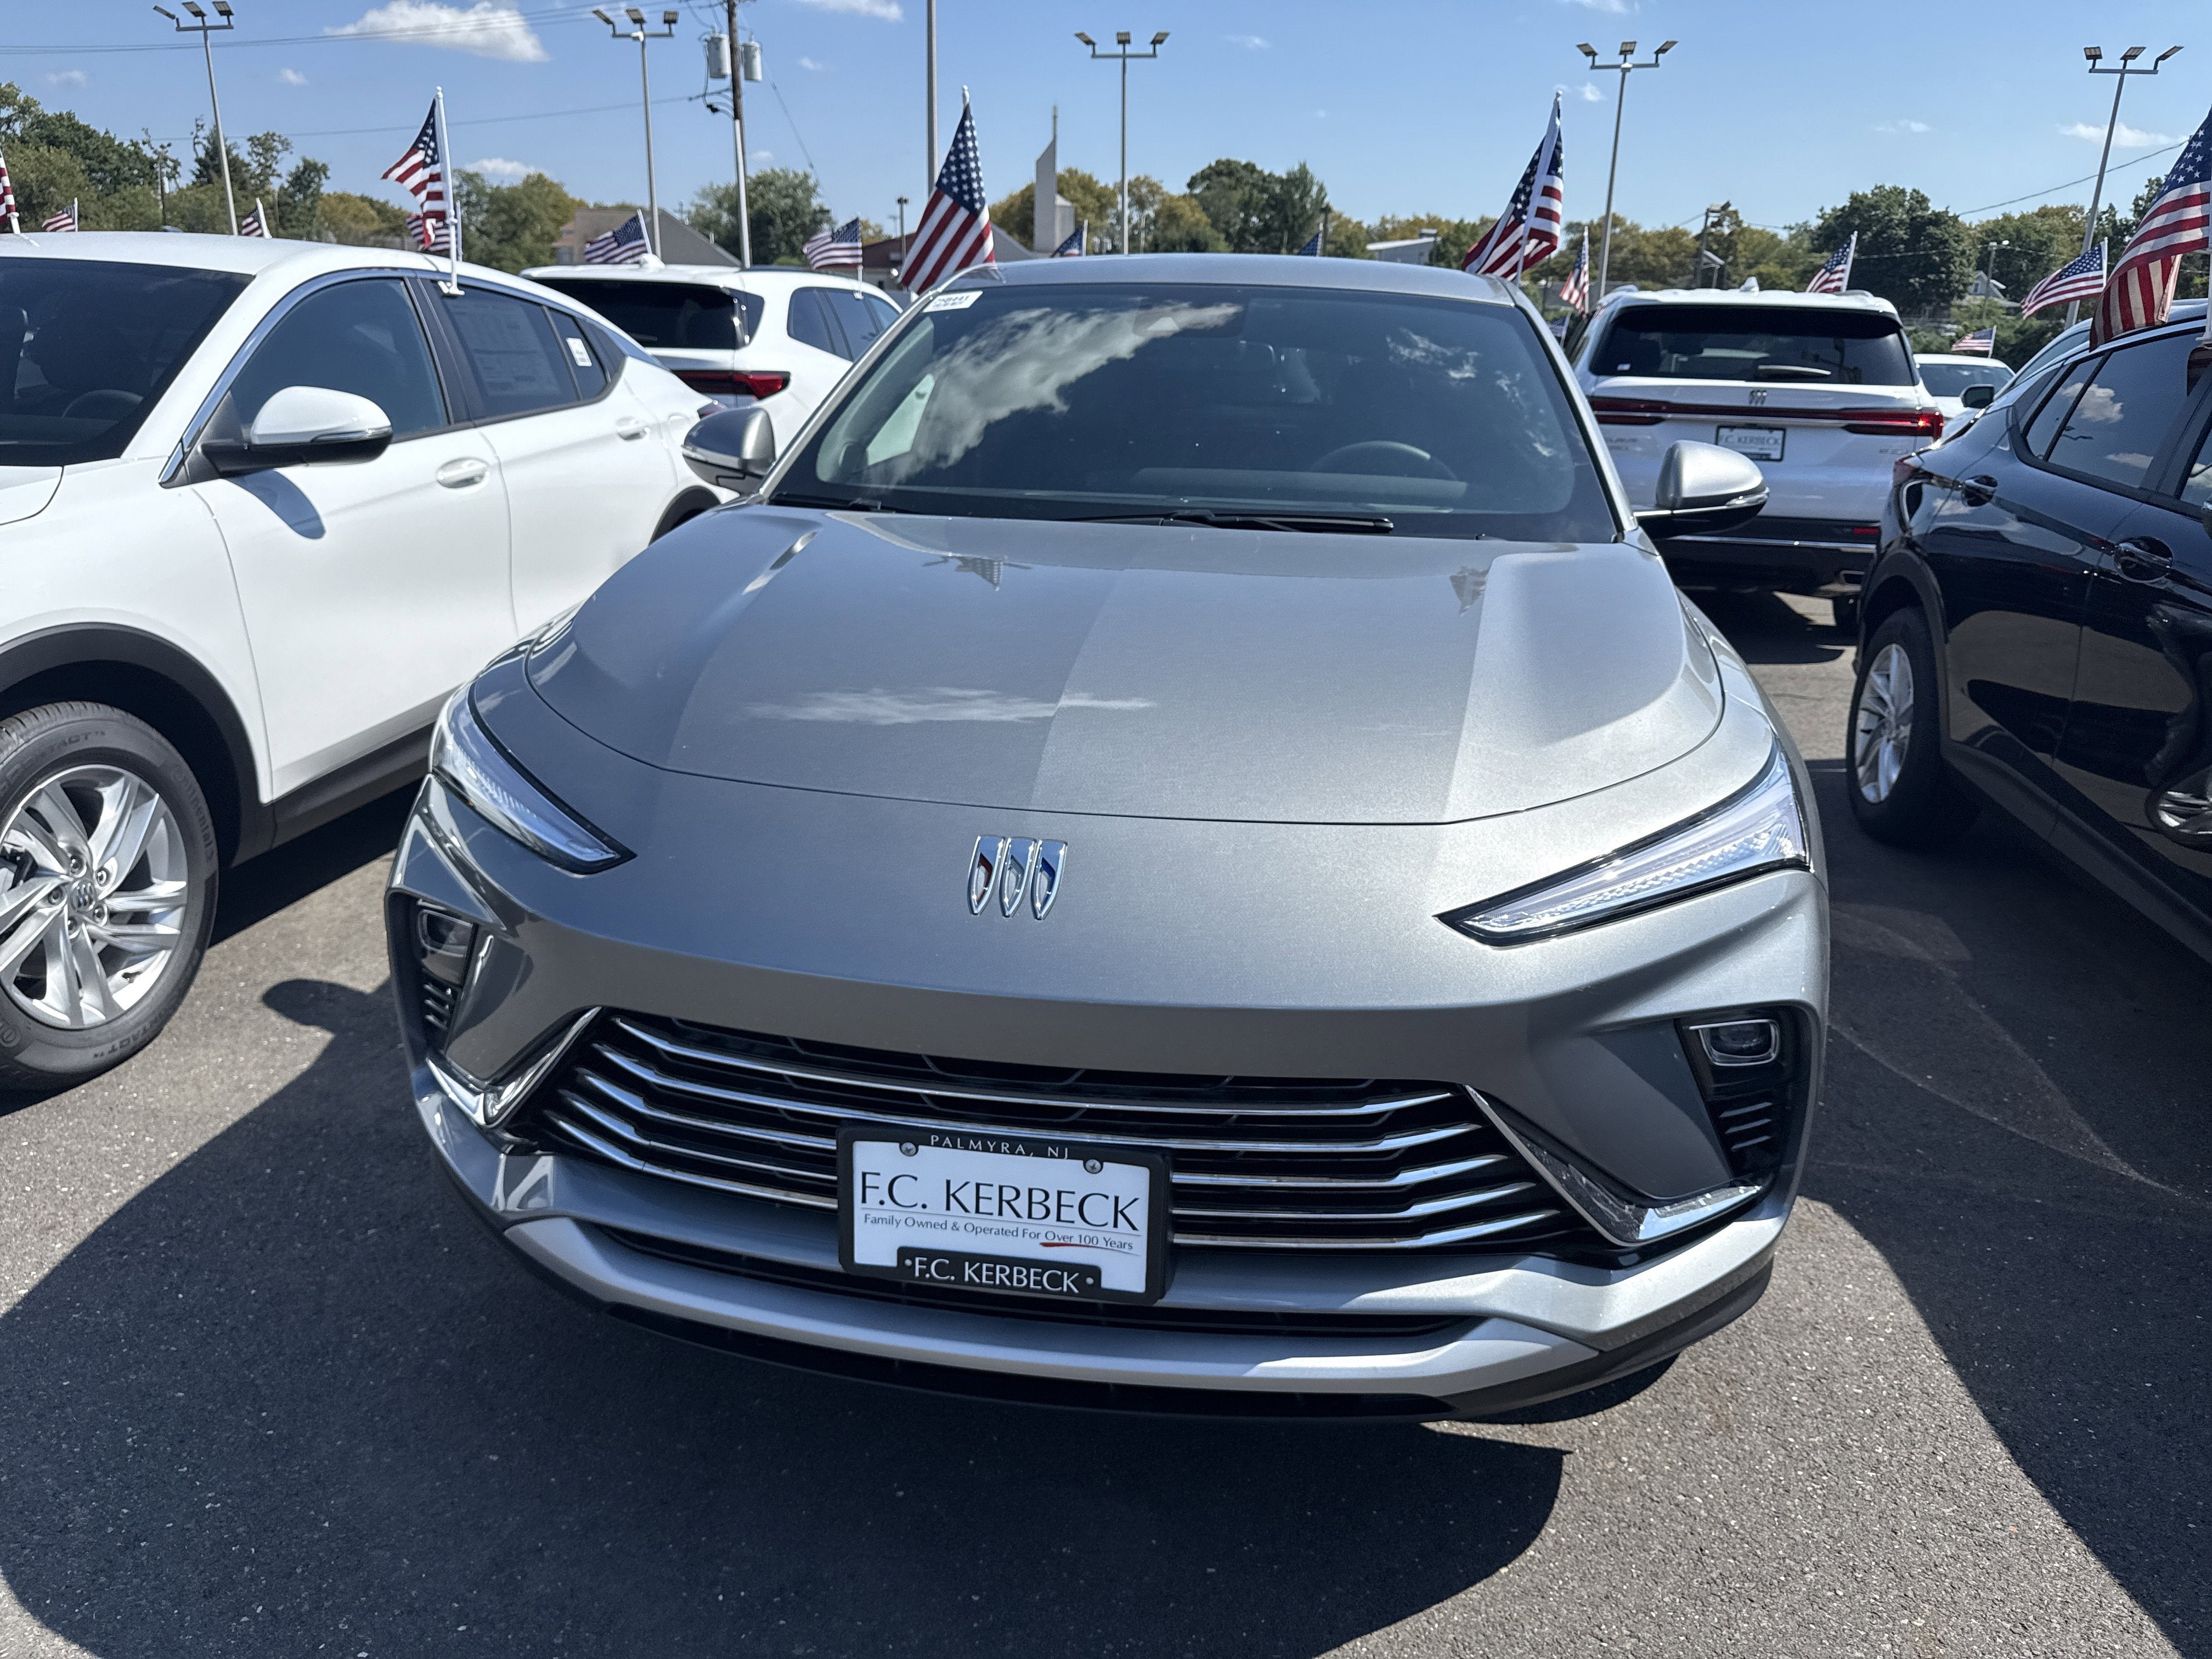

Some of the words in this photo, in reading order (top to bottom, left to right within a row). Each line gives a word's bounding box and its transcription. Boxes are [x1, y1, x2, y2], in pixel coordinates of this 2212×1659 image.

[930, 1134, 1034, 1158] PALMYRA,
[1047, 1146, 1069, 1159] NJ
[860, 1171, 928, 1209] F.C.
[945, 1178, 1140, 1232] KERBECK
[864, 1213, 901, 1228] Family
[905, 1216, 947, 1230] Owned
[951, 1223, 961, 1232] &
[964, 1222, 1019, 1238] Operated
[1022, 1228, 1041, 1239] For
[1045, 1231, 1074, 1243] Over
[1077, 1234, 1099, 1245] 100
[1102, 1236, 1133, 1250] Years
[914, 1256, 955, 1280] F.C.
[964, 1261, 1080, 1294] KERBECK
